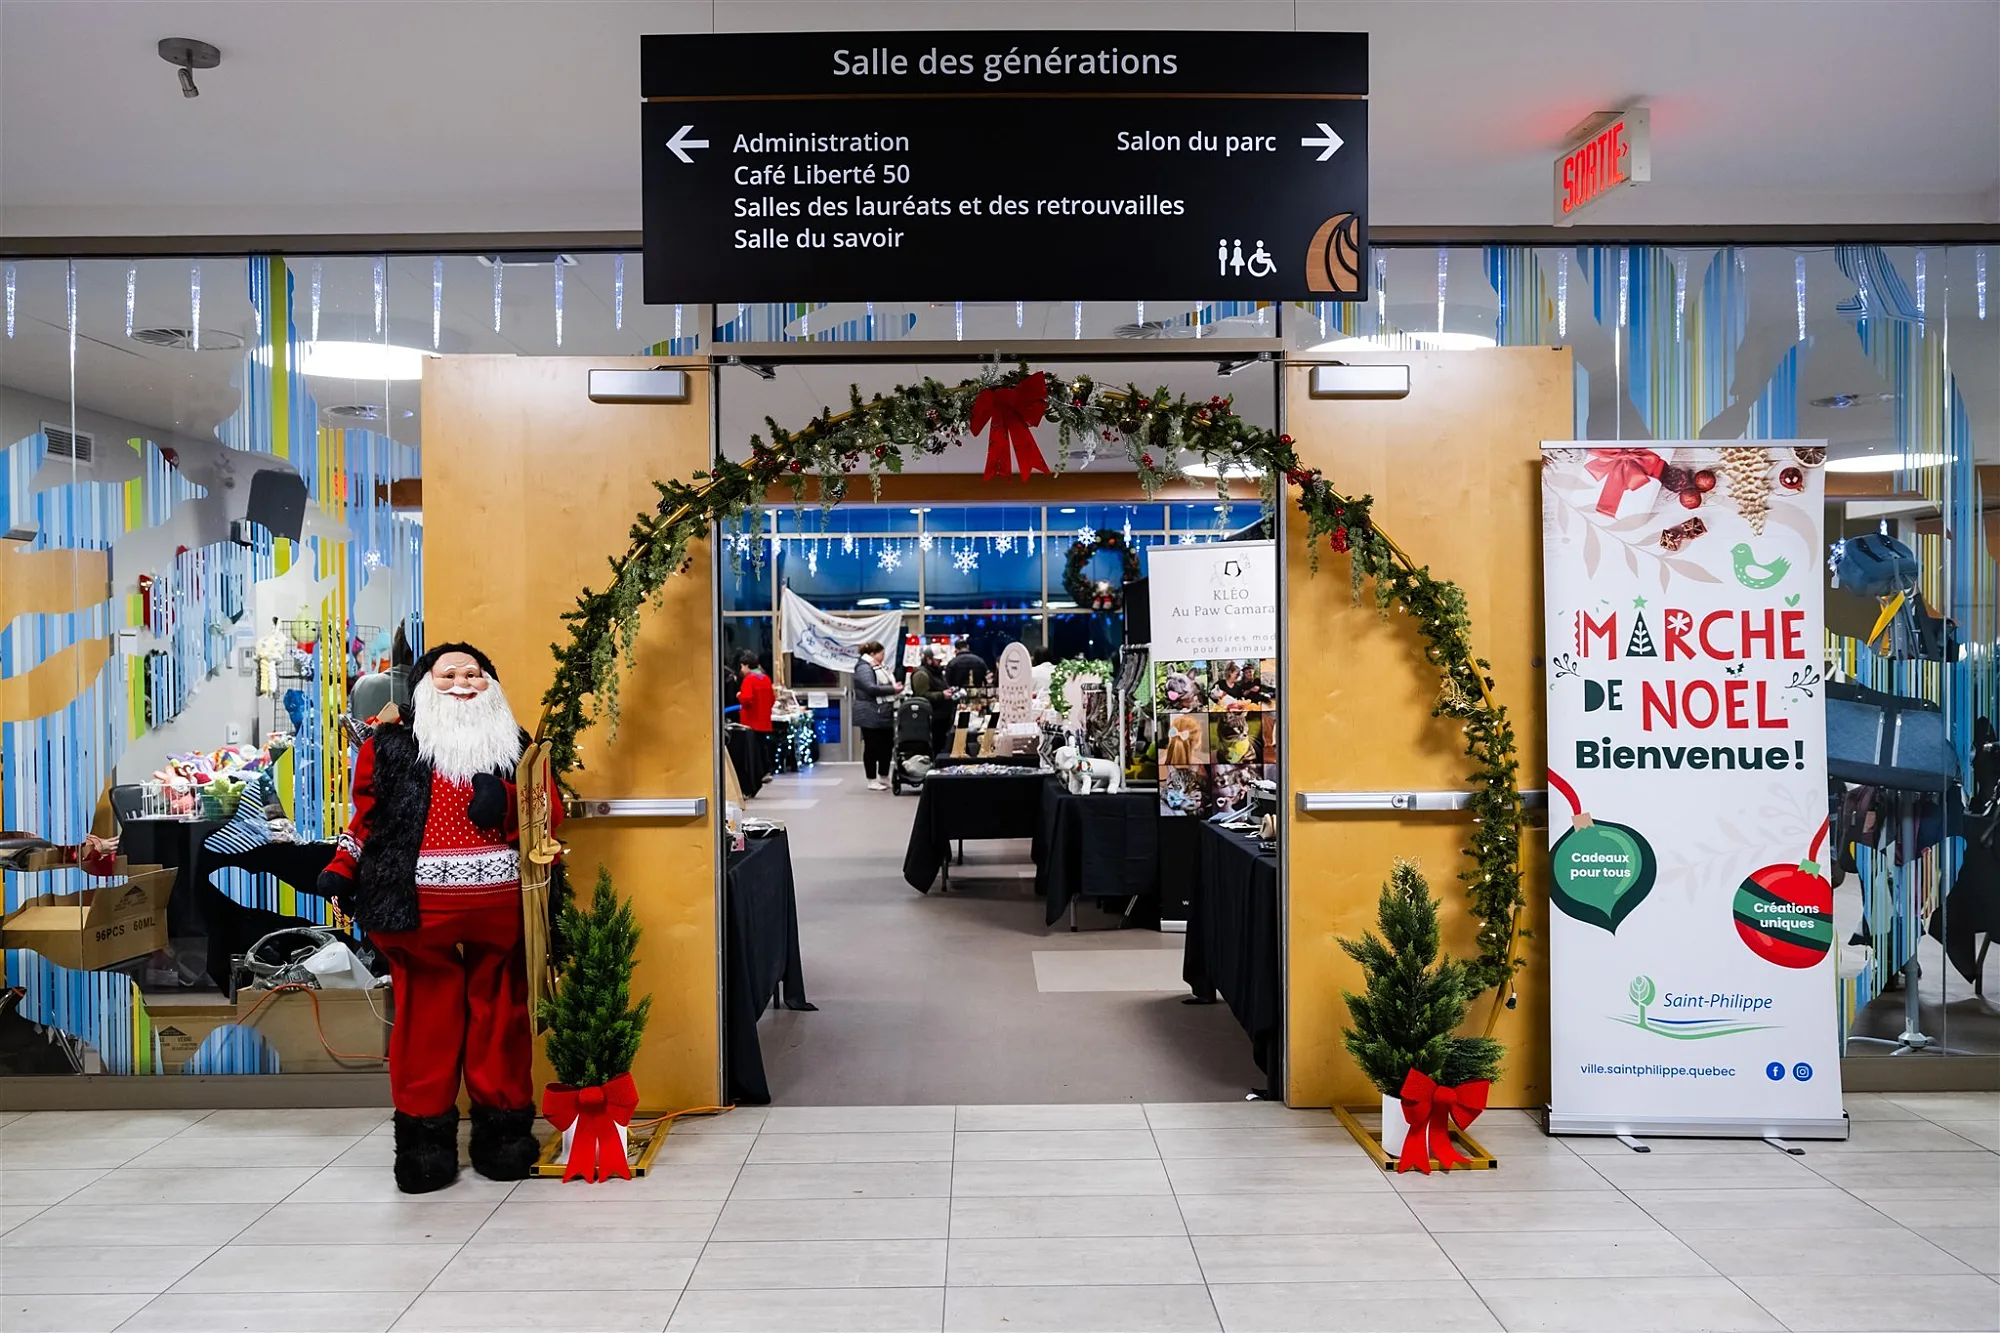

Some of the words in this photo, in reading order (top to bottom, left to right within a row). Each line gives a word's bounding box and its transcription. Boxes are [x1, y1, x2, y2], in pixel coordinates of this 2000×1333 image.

[833, 47, 908, 76] Salle
[918, 47, 974, 75] des
[984, 46, 1178, 82] générations
[732, 131, 909, 153] Administration
[1117, 130, 1181, 151] Salon
[1188, 130, 1218, 151] du
[1226, 136, 1277, 157] parc
[734, 163, 786, 185] Café
[794, 163, 876, 184] Liberté
[883, 165, 910, 184] 50
[1563, 122, 1624, 213] SORTIE
[734, 196, 801, 217] Salles
[807, 196, 849, 216] des
[857, 194, 952, 216] lauréats
[958, 197, 982, 216] et
[988, 194, 1030, 216] des
[1037, 194, 1185, 216] retrouvailles
[734, 227, 789, 249] Salle
[796, 227, 826, 248] du
[833, 227, 905, 248] savoir
[1213, 587, 1249, 600] KLÉO
[1172, 606, 1189, 617] Au
[1194, 605, 1220, 616] Paw
[1176, 635, 1246, 644] Accessoires
[1193, 645, 1219, 655] pour
[1224, 644, 1274, 653] animaux
[1584, 679, 1623, 712] DE
[1576, 736, 1805, 770] Bienvenue!
[1571, 852, 1630, 863] Cadeaux
[1570, 867, 1601, 880] pour
[1603, 867, 1631, 877] tous
[1753, 902, 1820, 914] Créations
[96, 925, 125, 942] 96PCS
[133, 916, 156, 931] 60ML
[1760, 917, 1815, 932] uniques
[1663, 992, 1773, 1012] Saint-Philippe
[1580, 1063, 1736, 1079] ville.saintphilippe.quebec
